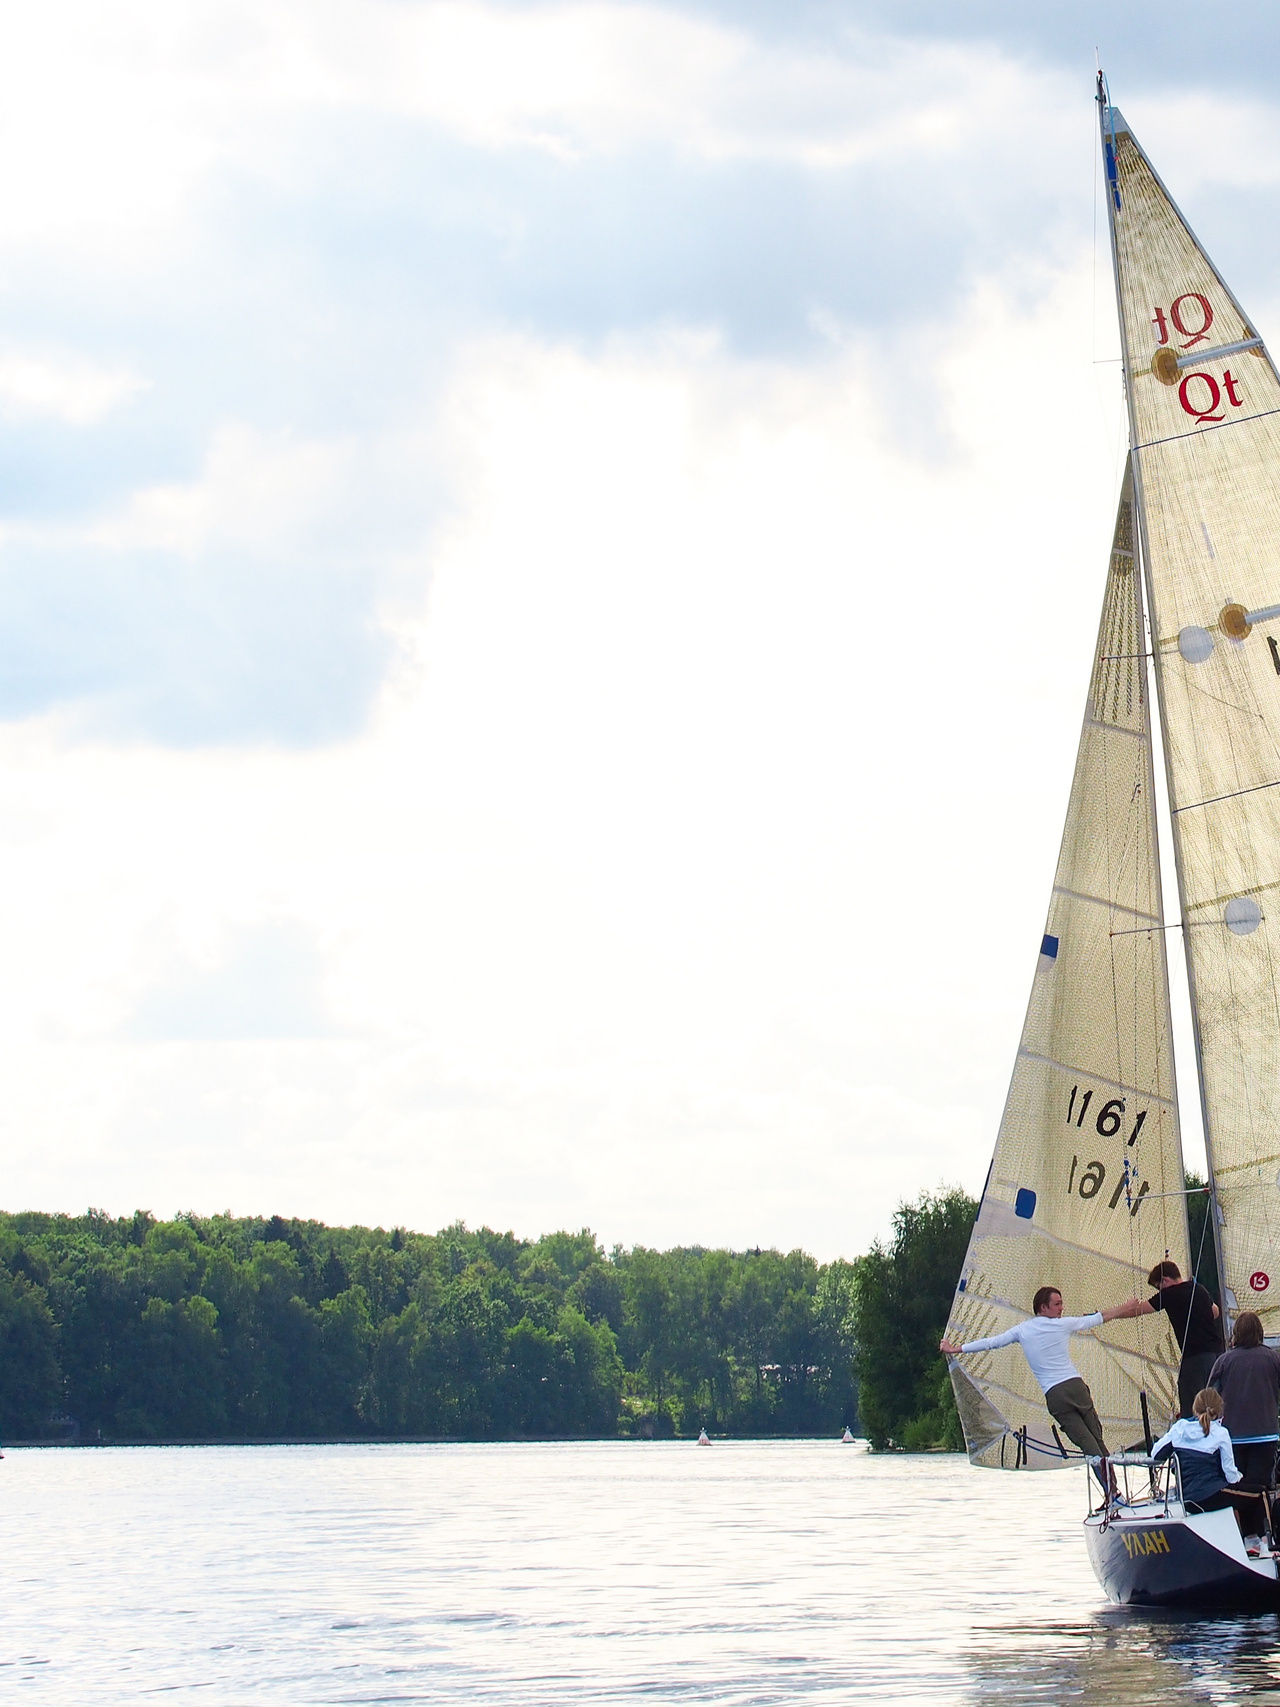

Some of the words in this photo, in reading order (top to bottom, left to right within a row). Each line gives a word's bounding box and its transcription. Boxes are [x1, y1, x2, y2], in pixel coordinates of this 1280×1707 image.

[1178, 370, 1243, 425] Qt
[1066, 1085, 1147, 1147] 1161
[1120, 1530, 1170, 1560] УЛАН
